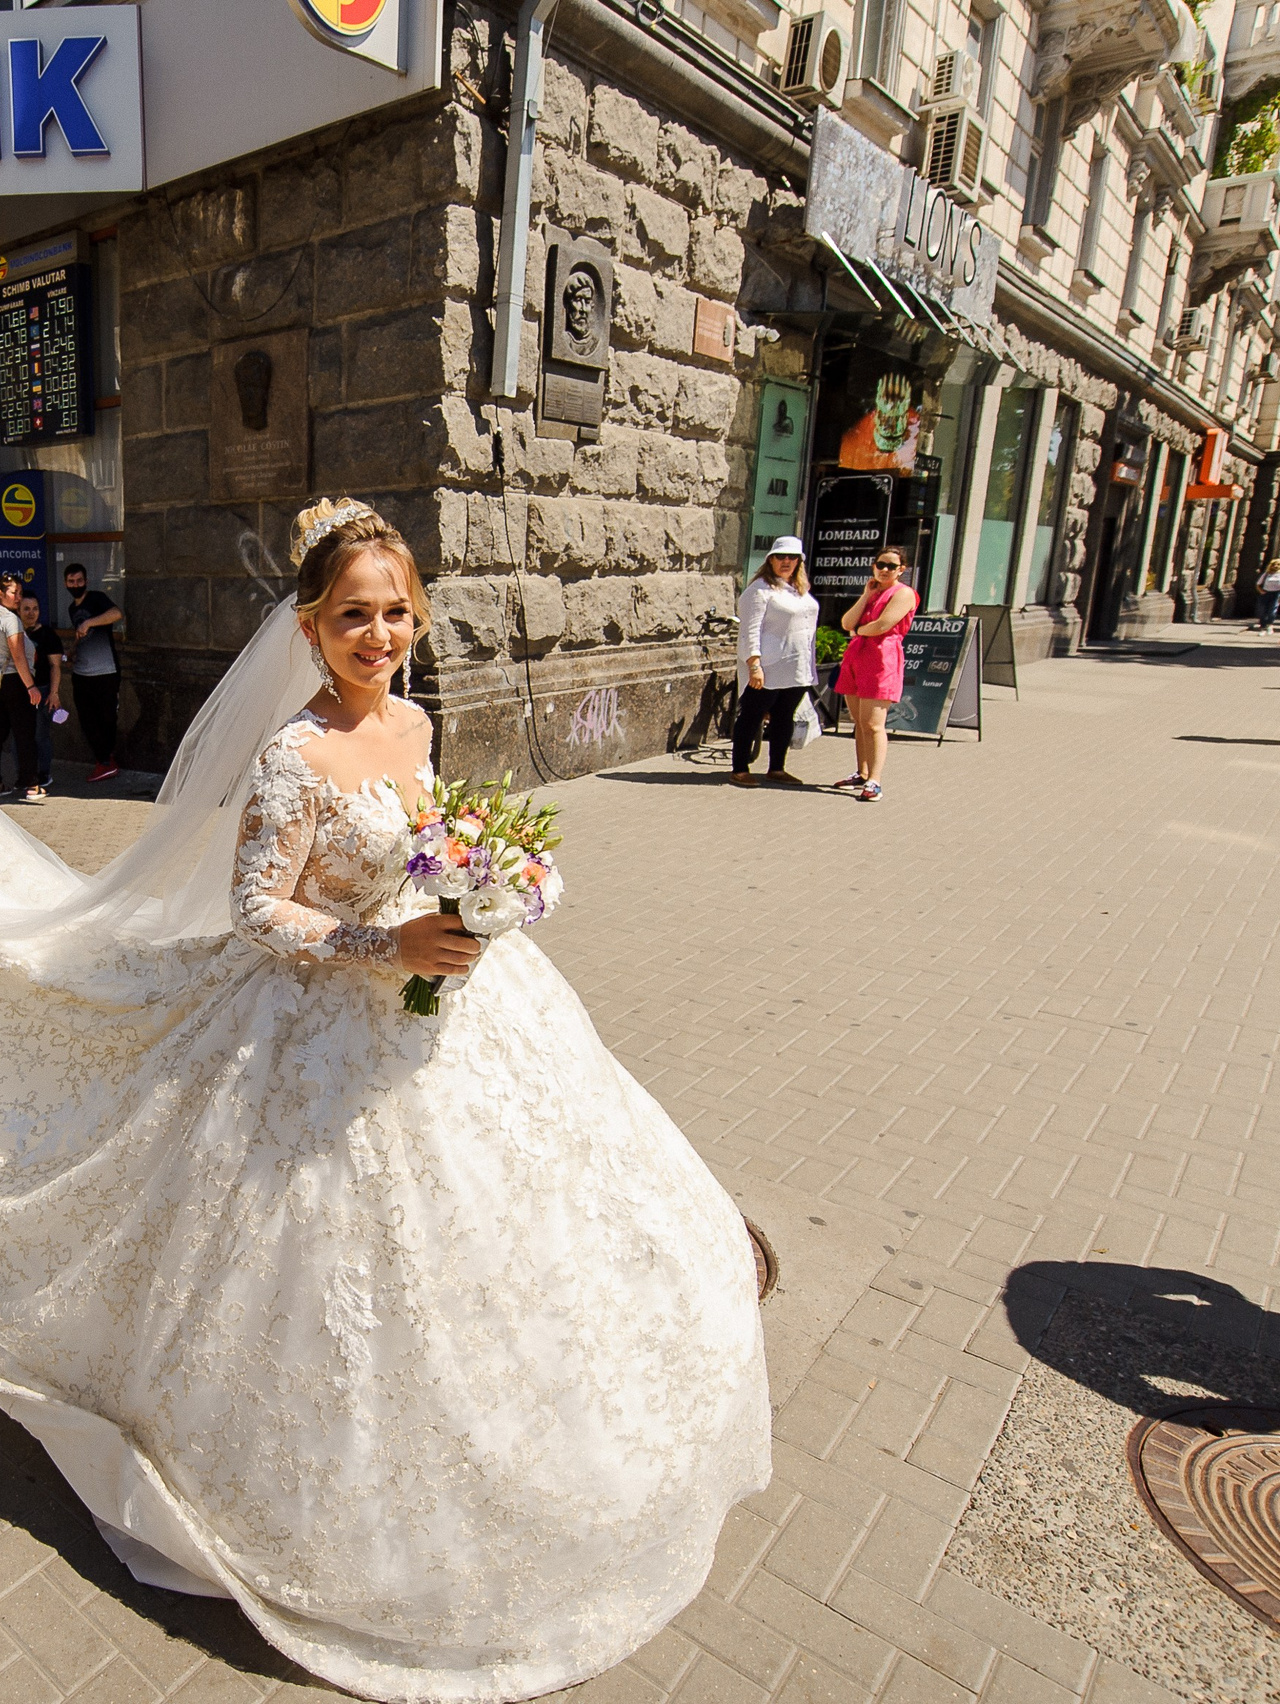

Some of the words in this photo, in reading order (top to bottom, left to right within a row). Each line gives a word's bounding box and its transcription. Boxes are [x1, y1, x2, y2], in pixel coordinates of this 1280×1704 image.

[2, 280, 31, 298] SCHIMB
[31, 269, 66, 289] VALUTAR
[766, 478, 789, 497] AUR
[818, 529, 880, 541] LOMBARD
[910, 620, 965, 633] MBARD
